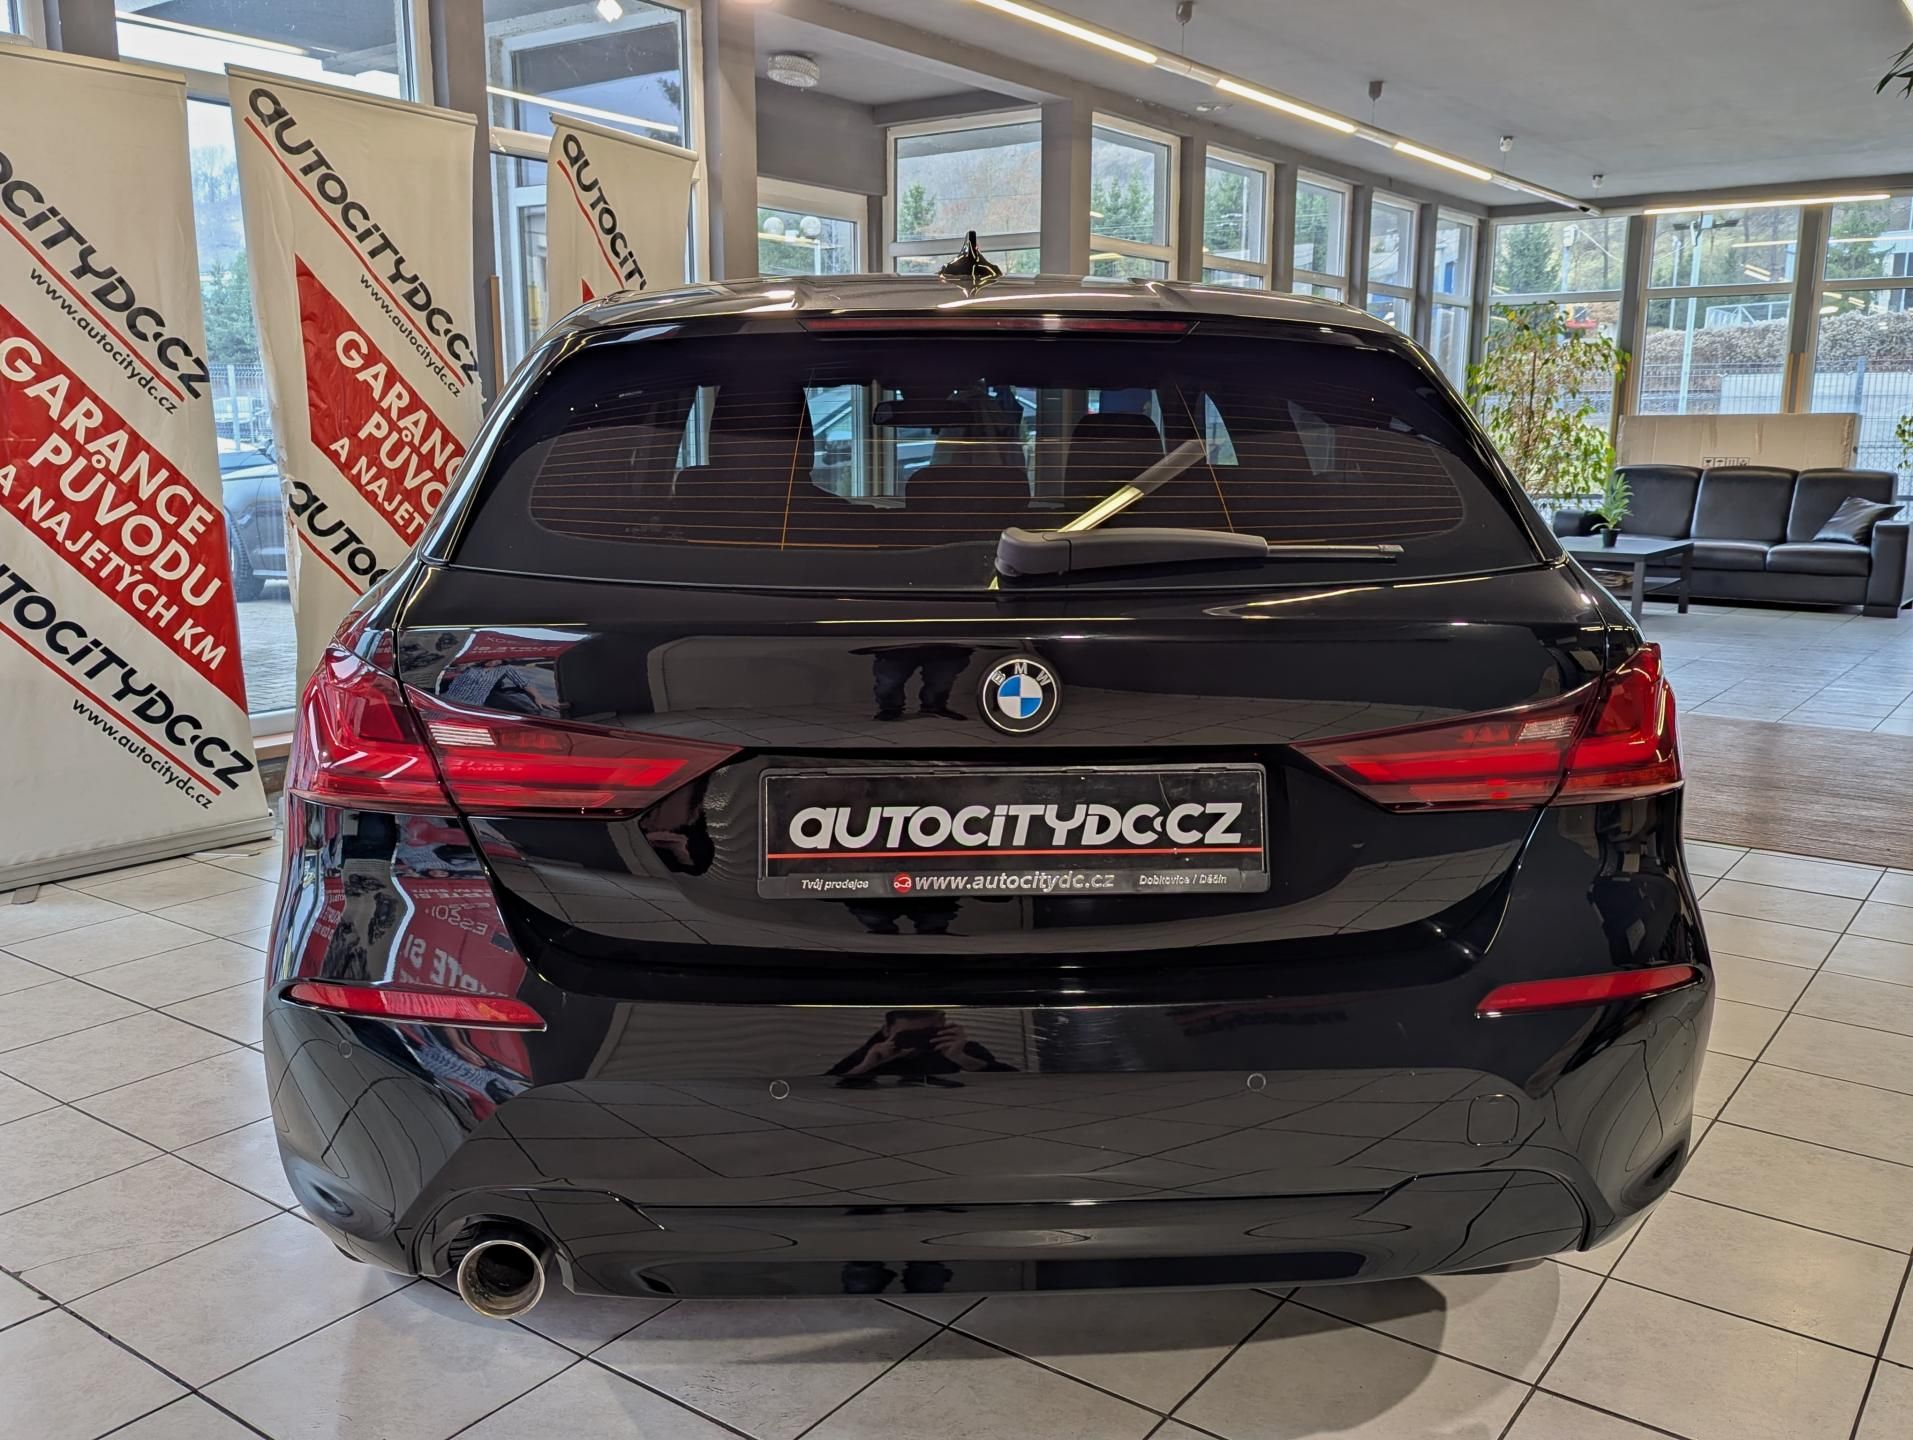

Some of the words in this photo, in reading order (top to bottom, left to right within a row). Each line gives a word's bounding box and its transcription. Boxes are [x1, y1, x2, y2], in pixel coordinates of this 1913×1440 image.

[30, 267, 178, 415] www.autocitydc.cz
[359, 274, 461, 398] www.autocitydc.cz
[0, 336, 215, 545] GARANCE
[329, 436, 351, 463] A
[351, 456, 428, 535] NAJET
[0, 464, 17, 497] A
[18, 486, 180, 628] NAJETÝCH
[173, 618, 228, 671] KM
[27, 432, 222, 607] PŮVODU
[991, 662, 1052, 686] BMW
[72, 698, 214, 810] www.autocitydc.cz
[801, 878, 823, 891] Tvůj
[824, 879, 869, 891] prodejce
[915, 870, 1115, 893] www.autocitydc.cz
